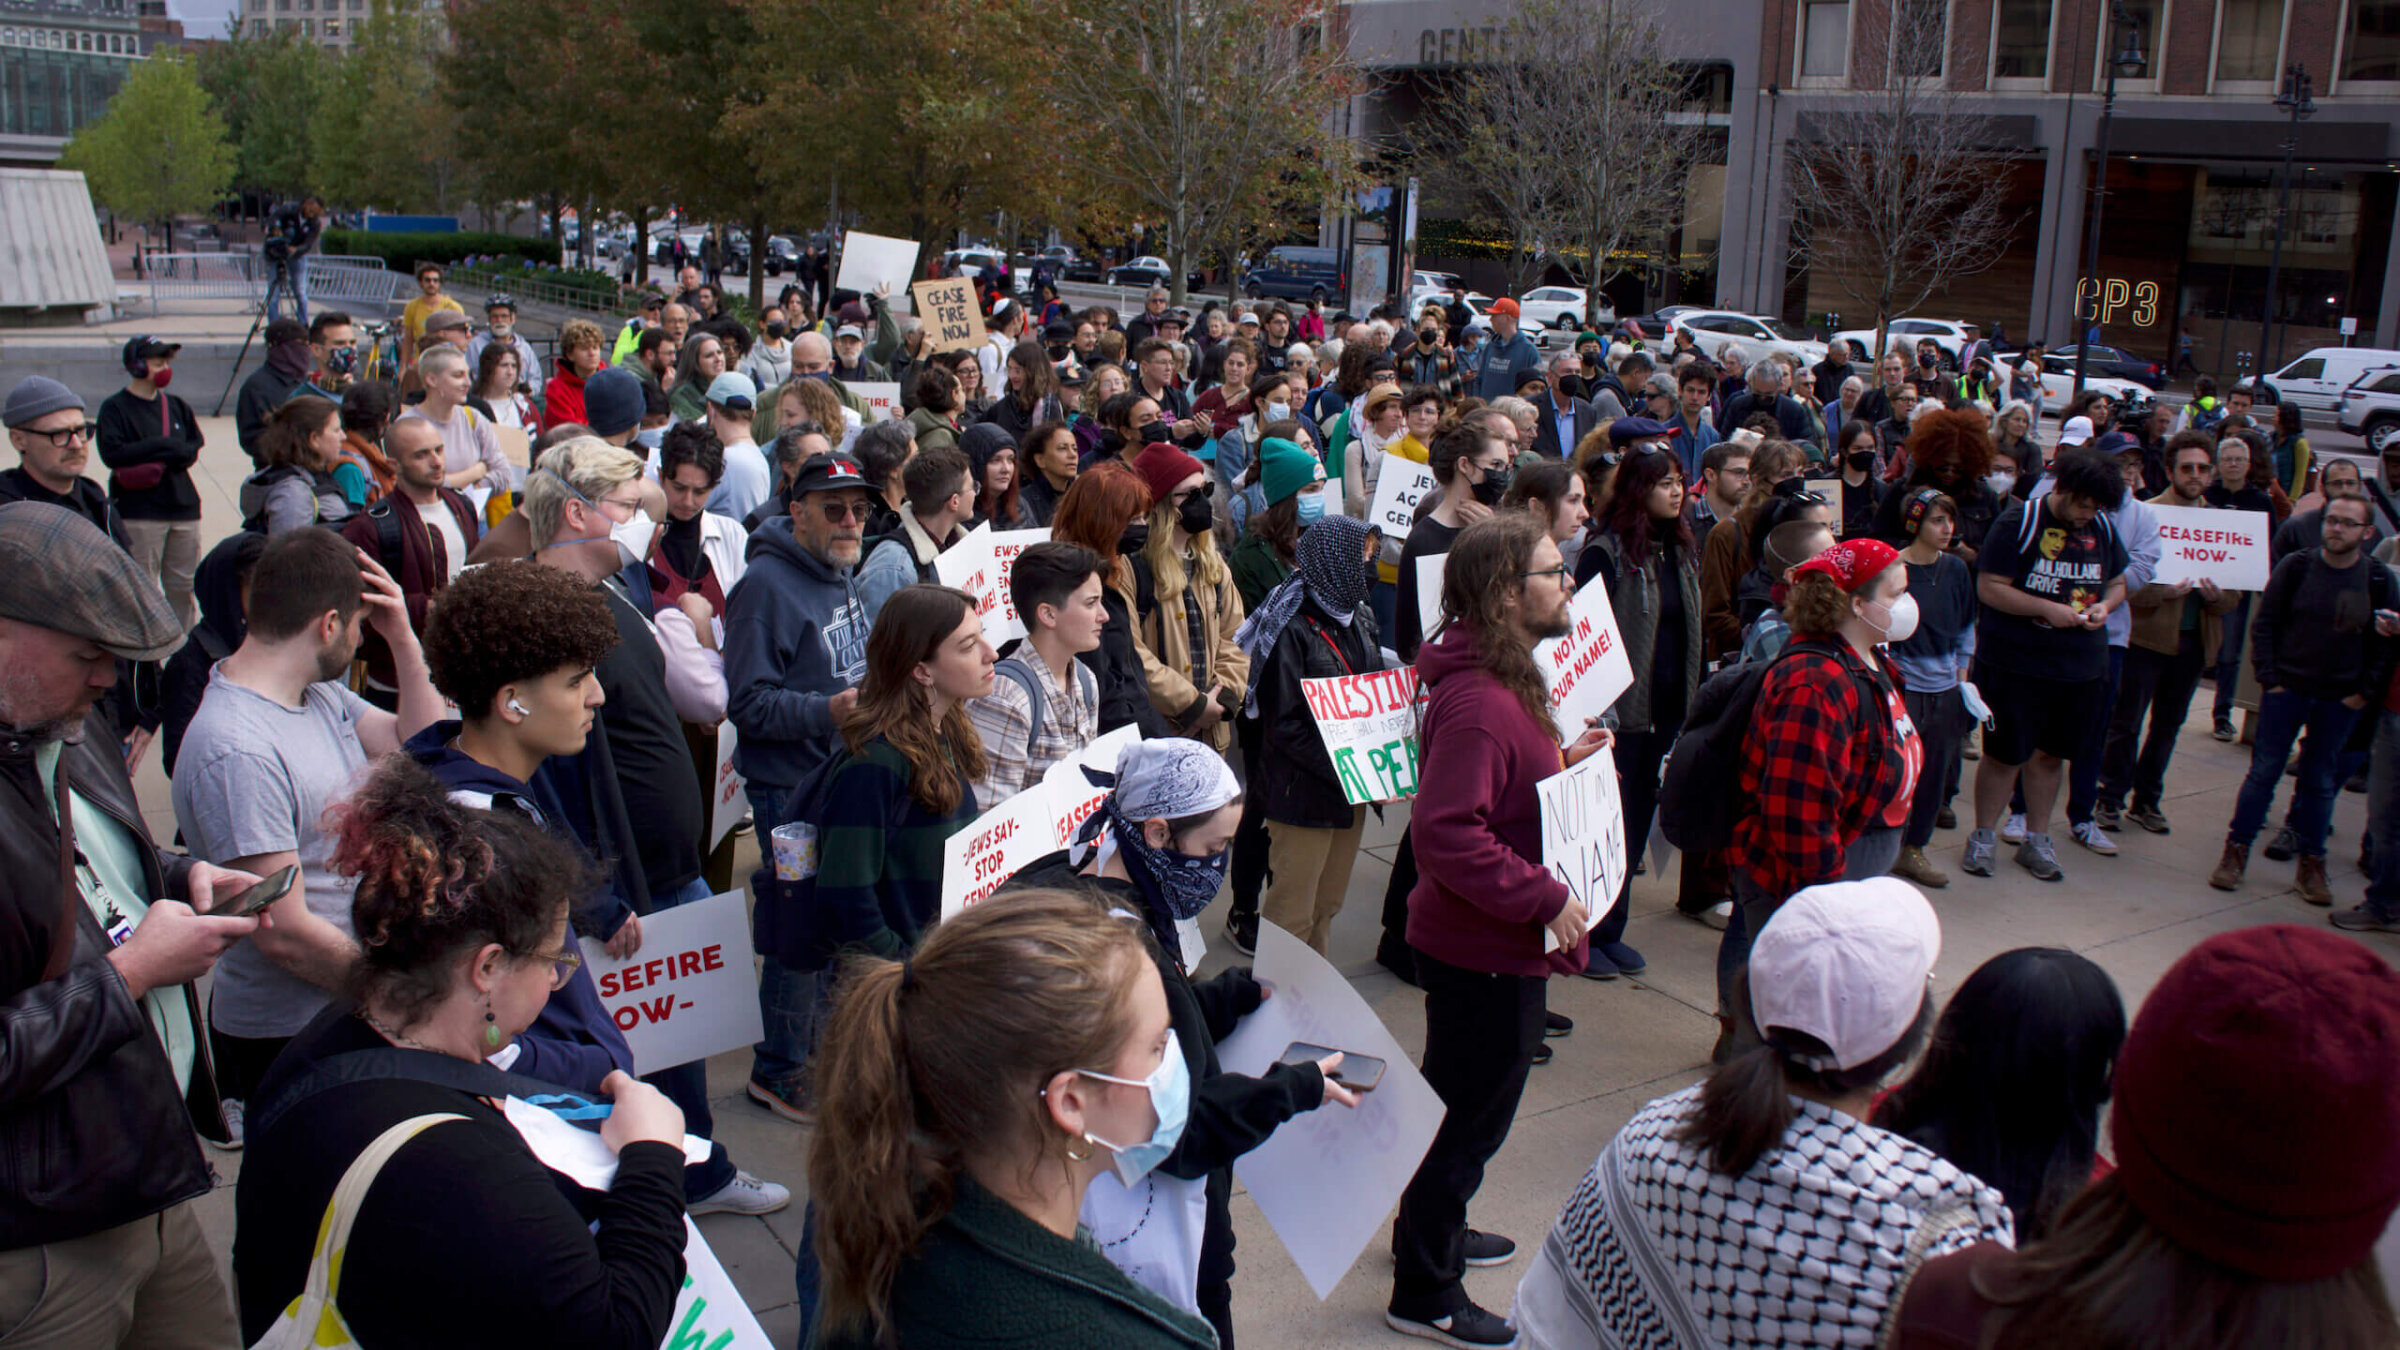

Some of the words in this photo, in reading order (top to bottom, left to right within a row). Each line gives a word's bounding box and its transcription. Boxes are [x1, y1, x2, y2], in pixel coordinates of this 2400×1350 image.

[927, 287, 967, 306] CEASE
[938, 305, 967, 323] FIRE
[942, 322, 970, 342] NOW
[2160, 525, 2254, 546] CEASEFIRE
[2174, 547, 2237, 562] -NOW-
[2025, 572, 2062, 594] DRIVE
[1553, 633, 1576, 669] NOT
[1576, 616, 1592, 641] IN
[1551, 671, 1575, 706] OUR
[1573, 629, 1613, 680] NAME!
[1334, 746, 1373, 803] AT
[1547, 767, 1588, 850] NOT
[975, 849, 1004, 882] STOP
